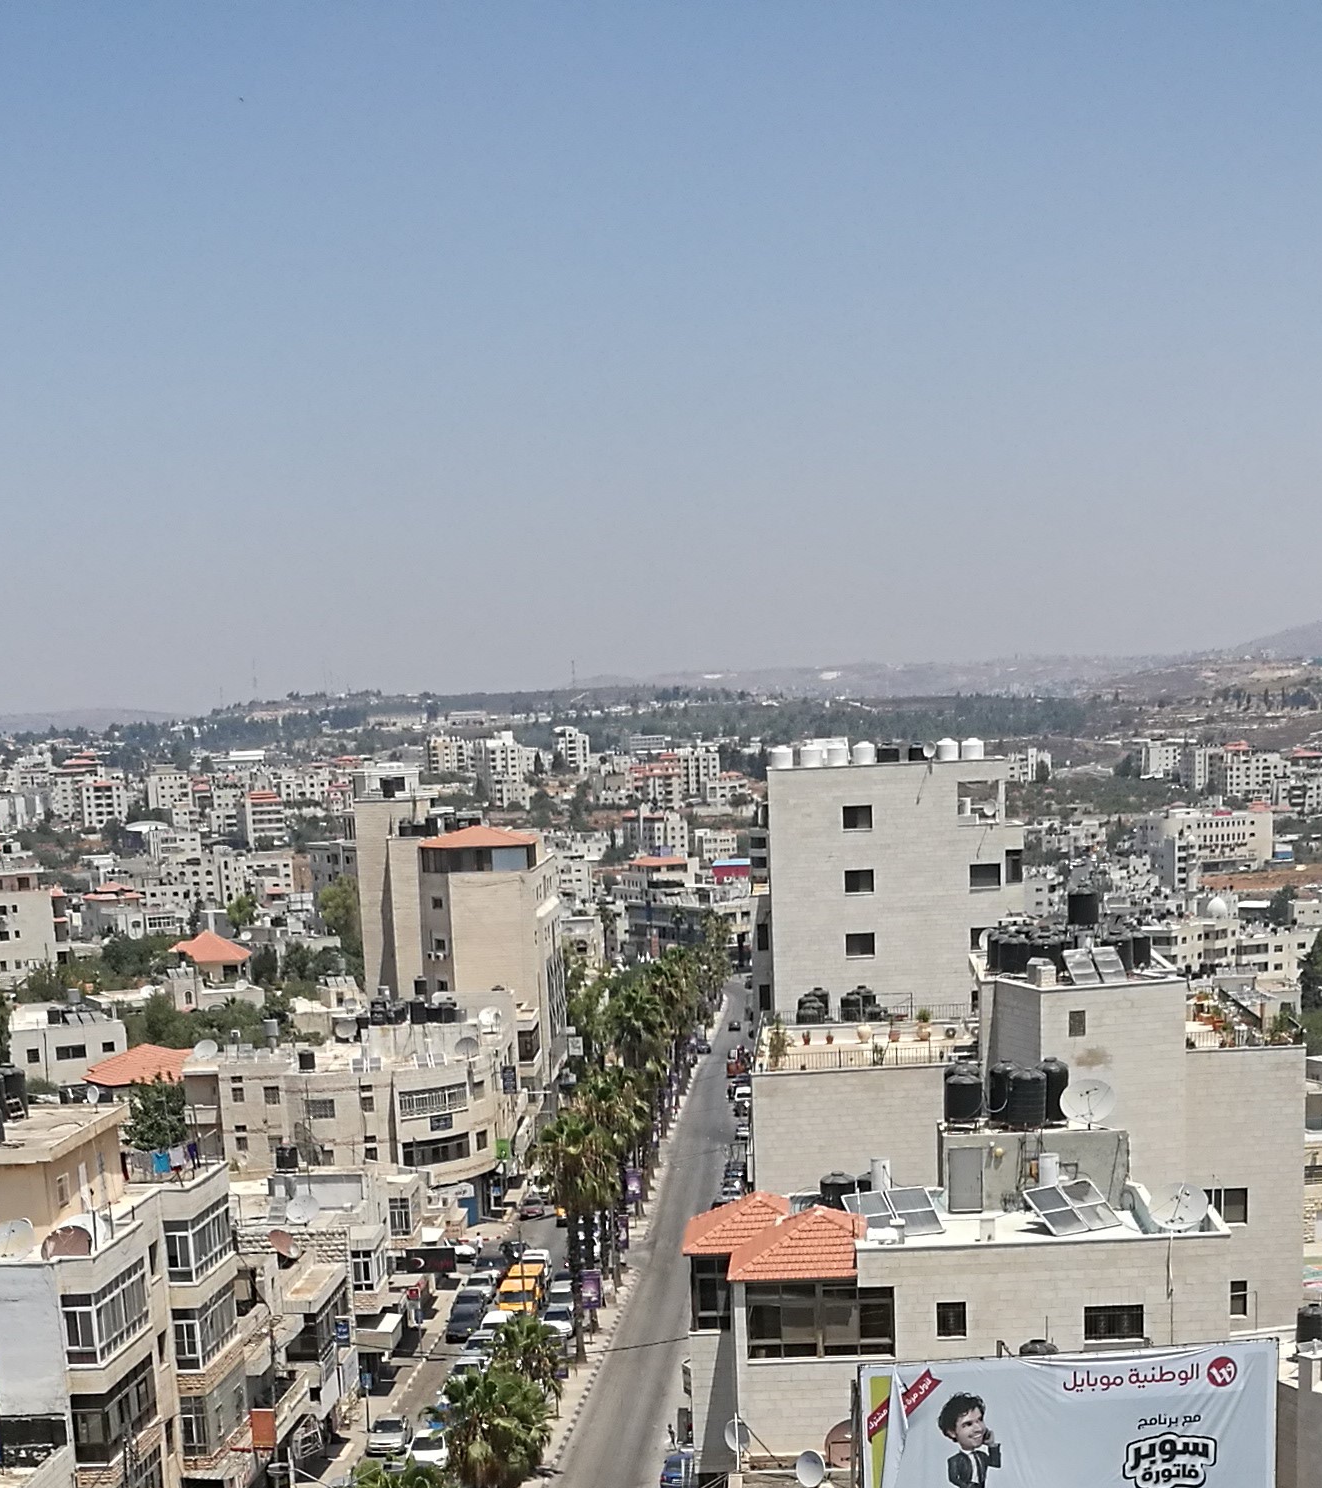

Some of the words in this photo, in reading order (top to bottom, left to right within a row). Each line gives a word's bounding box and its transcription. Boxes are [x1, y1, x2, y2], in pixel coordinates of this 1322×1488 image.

[1063, 1370, 1124, 1393] موبايل
[1128, 1362, 1200, 1389] الوطنية
[1137, 1412, 1179, 1430] برنامج
[1181, 1413, 1202, 1427] مع
[1130, 1437, 1210, 1471] سوبر
[1141, 1462, 1200, 1485] فاتورة
